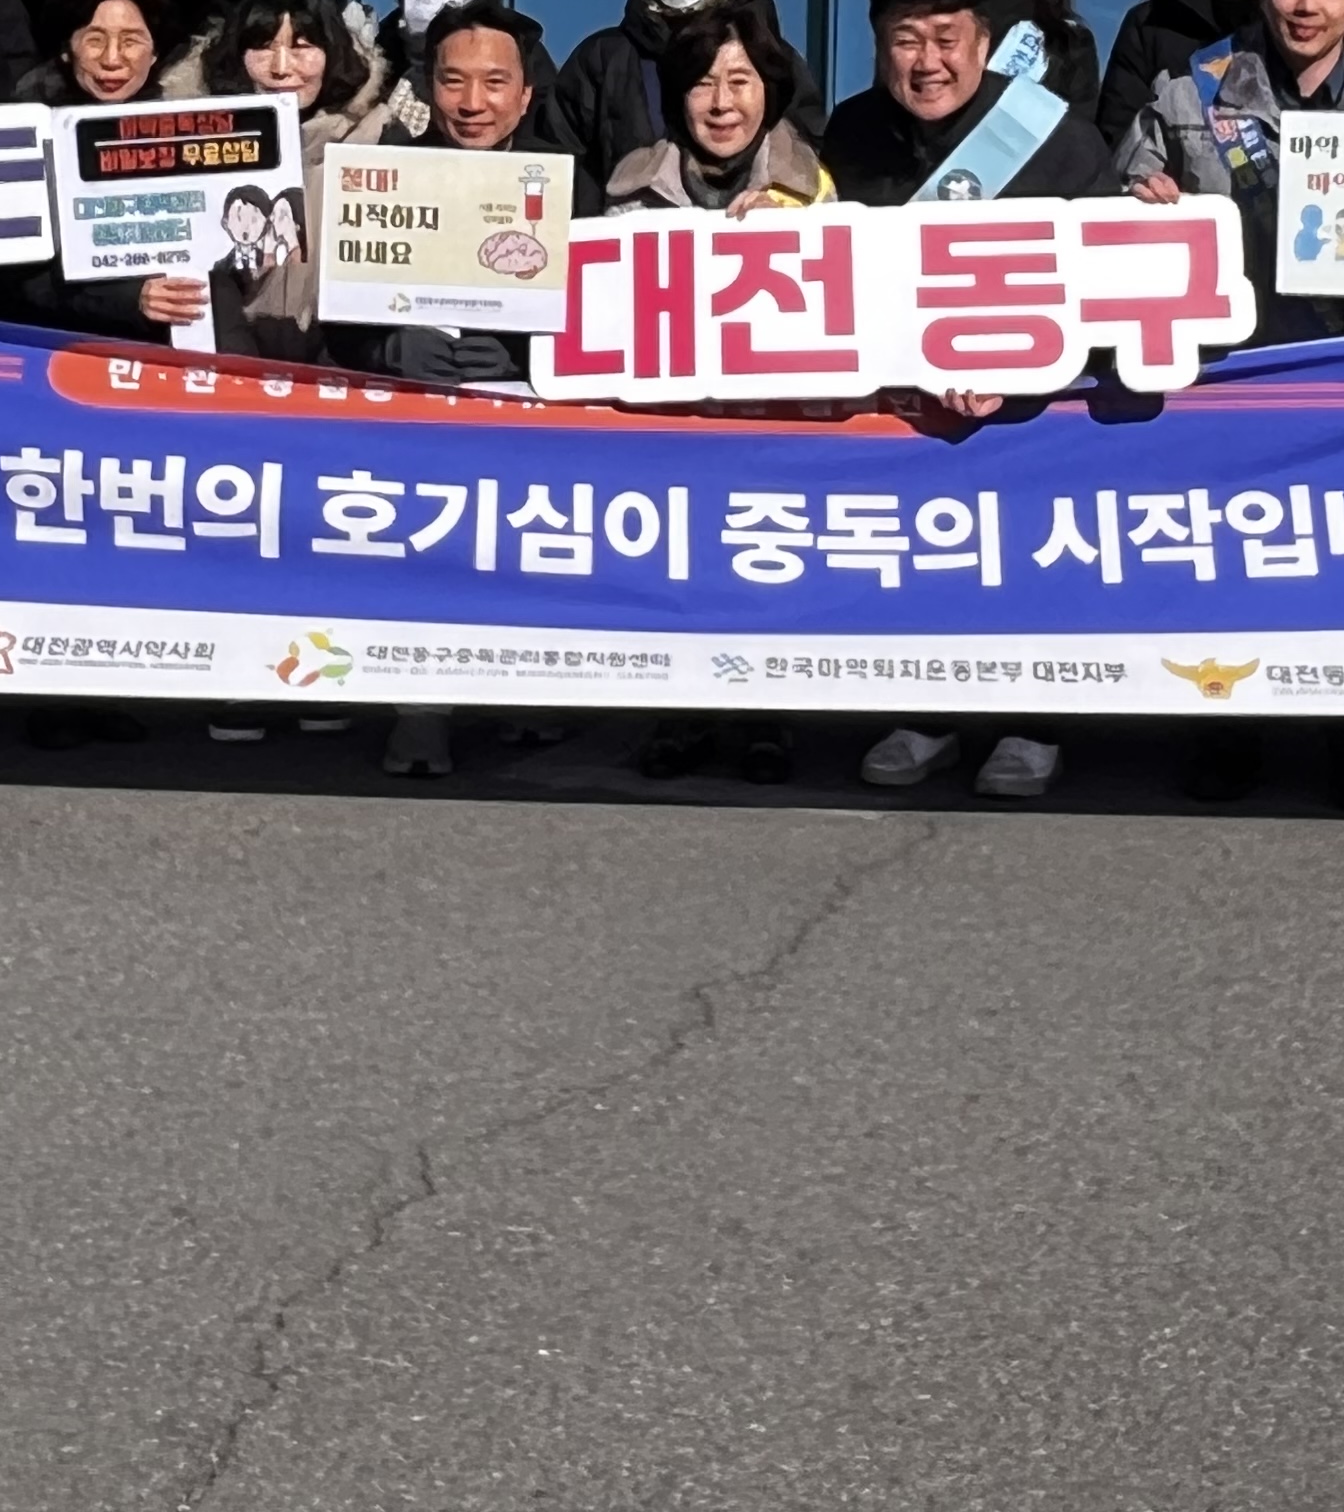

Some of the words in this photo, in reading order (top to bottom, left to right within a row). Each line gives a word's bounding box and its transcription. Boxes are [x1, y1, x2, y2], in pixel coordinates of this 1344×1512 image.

[1289, 135, 1339, 160] 마약
[341, 166, 399, 193] 절대!
[338, 203, 439, 231] 시작하지
[338, 239, 413, 266] 마세요
[554, 225, 859, 379] 대전
[916, 218, 1232, 370] 동구
[0, 443, 283, 558] 한번의
[311, 470, 690, 580] 호기심이
[719, 486, 1003, 588] 중독의
[1032, 660, 1127, 683] 대전지부
